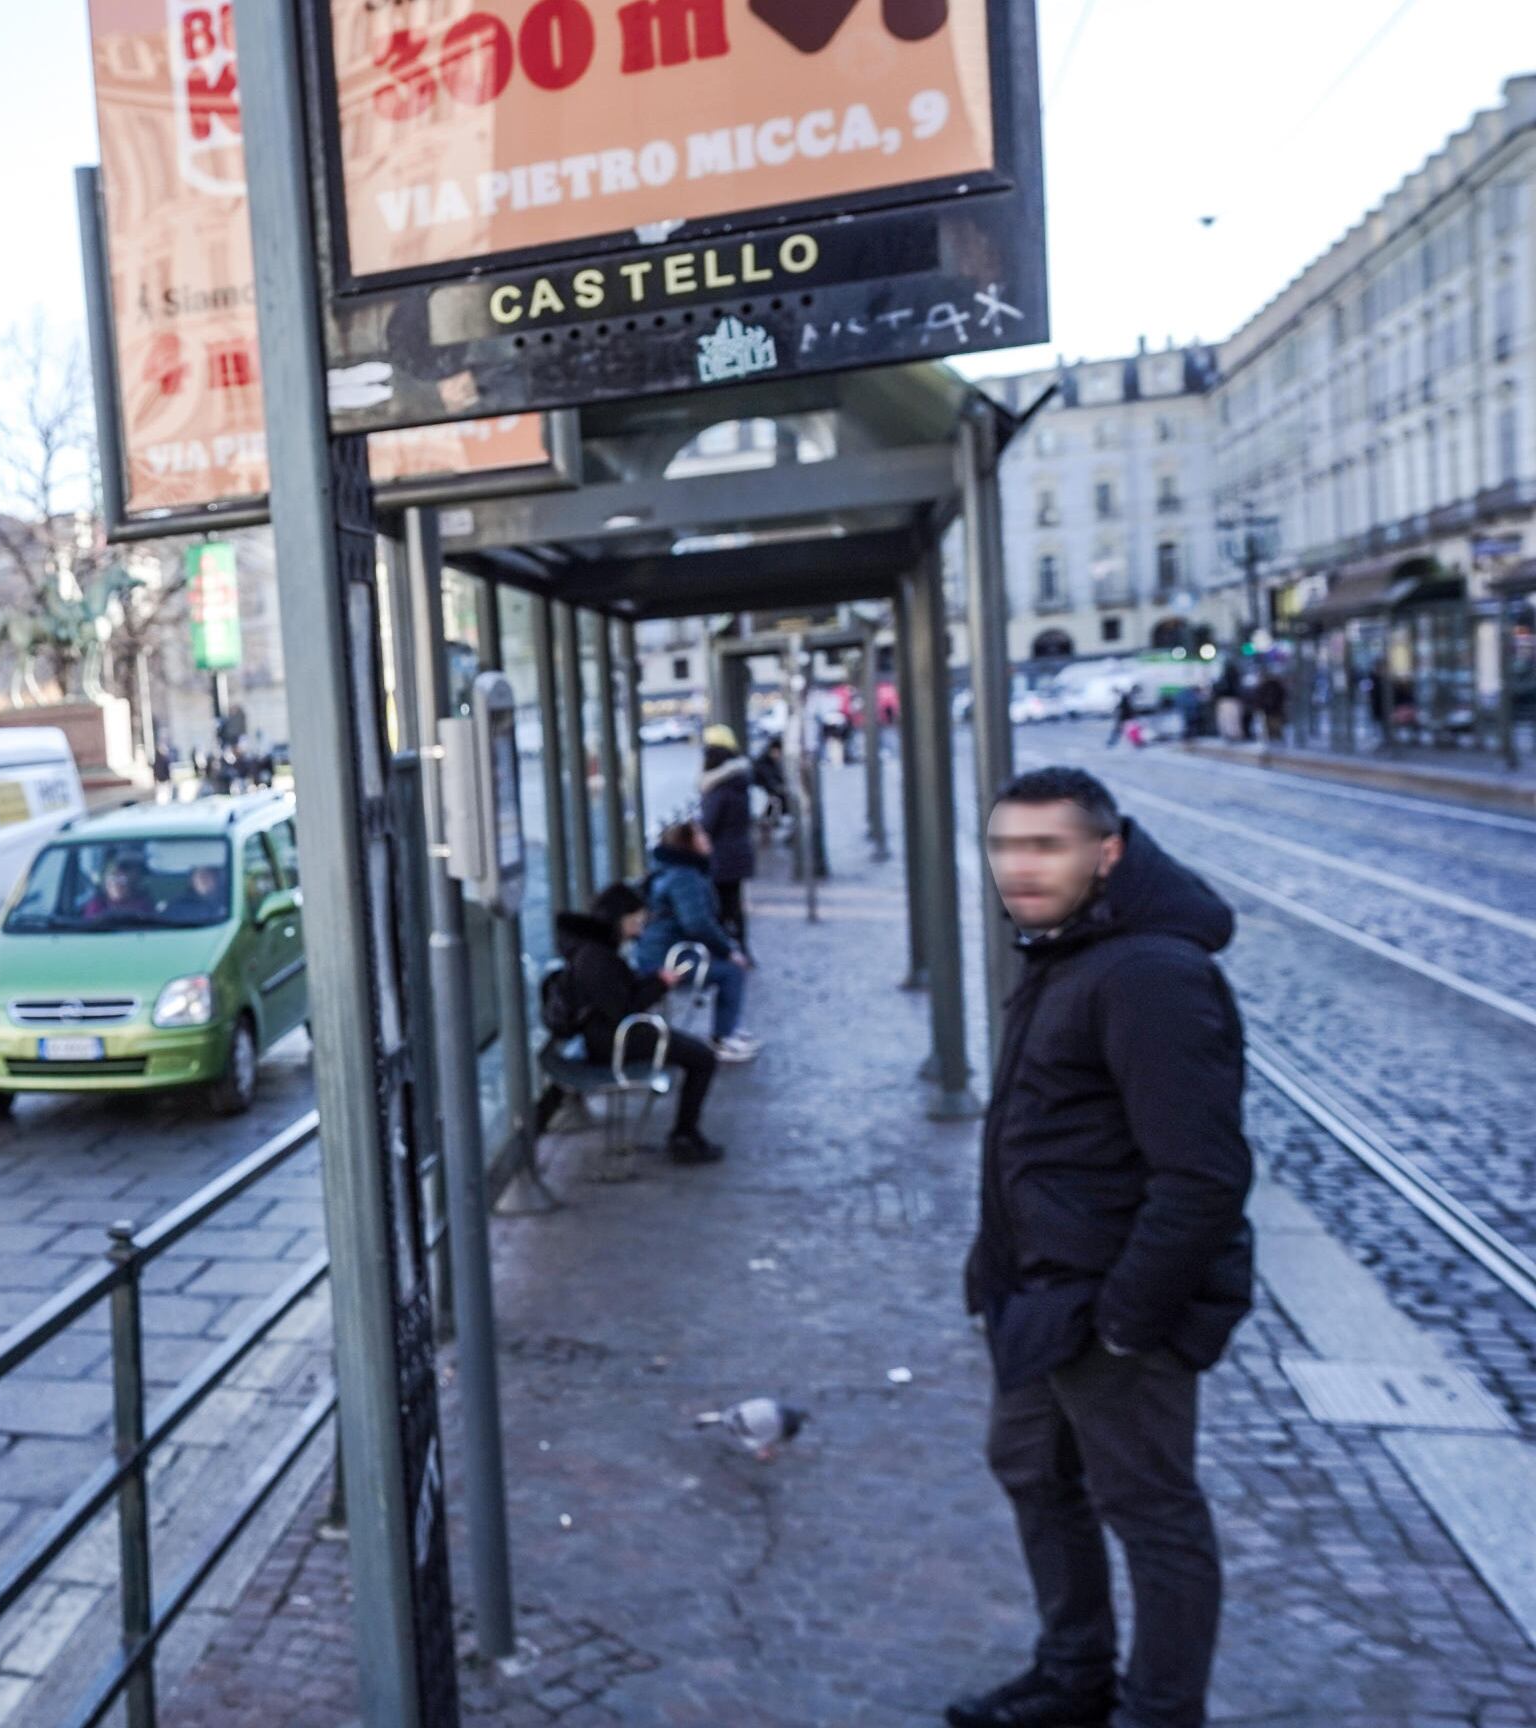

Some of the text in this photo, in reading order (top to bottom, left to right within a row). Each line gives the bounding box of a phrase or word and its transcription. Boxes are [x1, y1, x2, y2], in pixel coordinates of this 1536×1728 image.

[376, 88, 950, 233] VIA PIETRO MICCA, 9
[490, 233, 820, 325] CASTELLO
